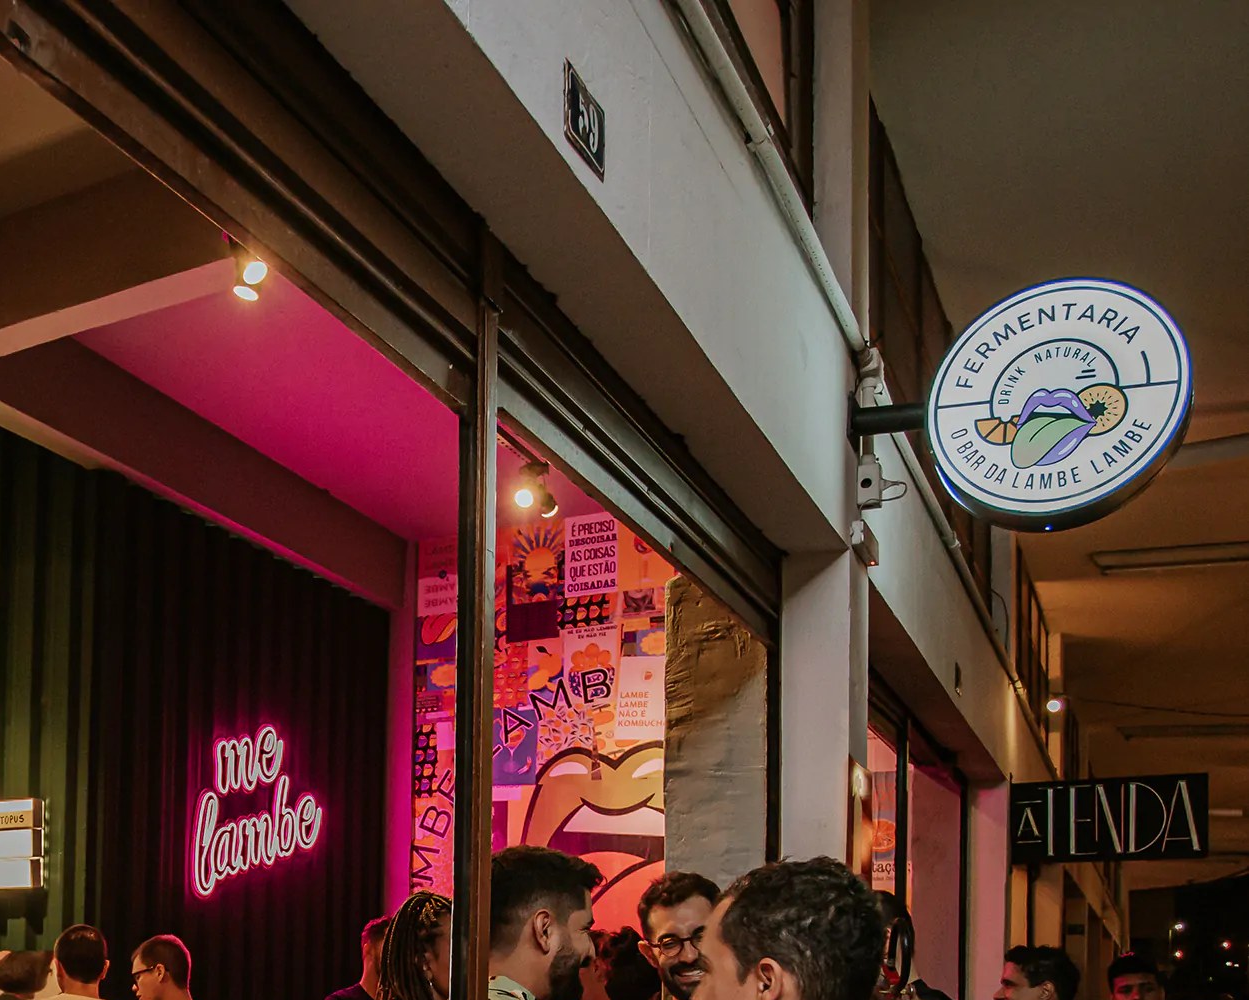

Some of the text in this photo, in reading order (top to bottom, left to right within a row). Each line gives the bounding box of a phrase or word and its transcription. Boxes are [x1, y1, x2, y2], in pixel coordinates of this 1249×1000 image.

[955, 303, 1141, 389] FERMENTARIA
[998, 346, 1098, 405] DRINK NATURAL
[951, 418, 1152, 490] O BAR DA LAMBE LAMBE
[571, 519, 615, 537] É PRECISO
[569, 533, 618, 547] DESCOISAR
[570, 545, 616, 562] AS COISAS
[569, 561, 616, 582] QUE ESTÃO
[424, 583, 455, 595] AMBE
[424, 596, 454, 608] AMBE
[620, 691, 649, 699] LAMBE
[492, 668, 612, 757] AMB
[618, 709, 638, 717] NÃO
[216, 726, 284, 794] me
[1038, 780, 1202, 856] TENDA
[193, 774, 323, 896] lambe
